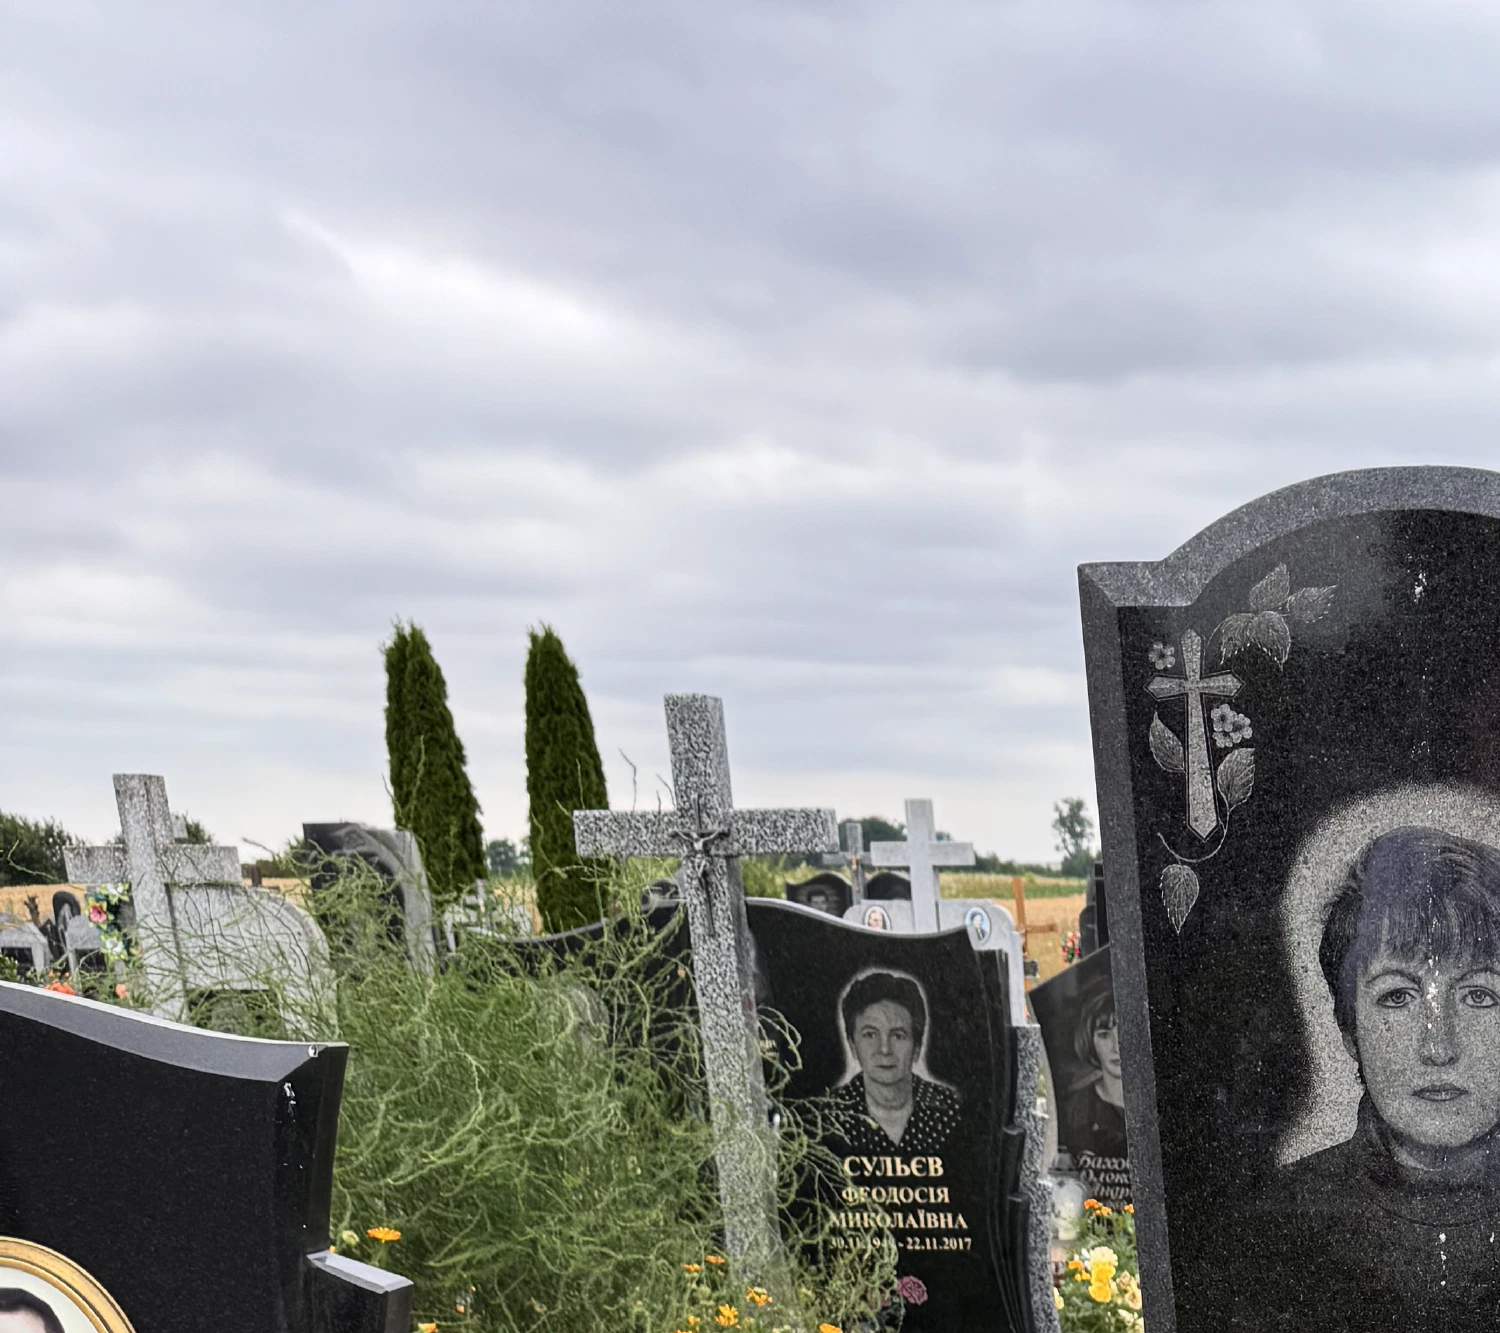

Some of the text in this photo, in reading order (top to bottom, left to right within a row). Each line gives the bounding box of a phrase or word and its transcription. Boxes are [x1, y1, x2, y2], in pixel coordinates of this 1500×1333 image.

[843, 1155, 944, 1177] СУЛЬЄВ
[842, 1186, 951, 1206] ФЕОДОСІЯ
[906, 1236, 972, 1250] 22.11.2017
